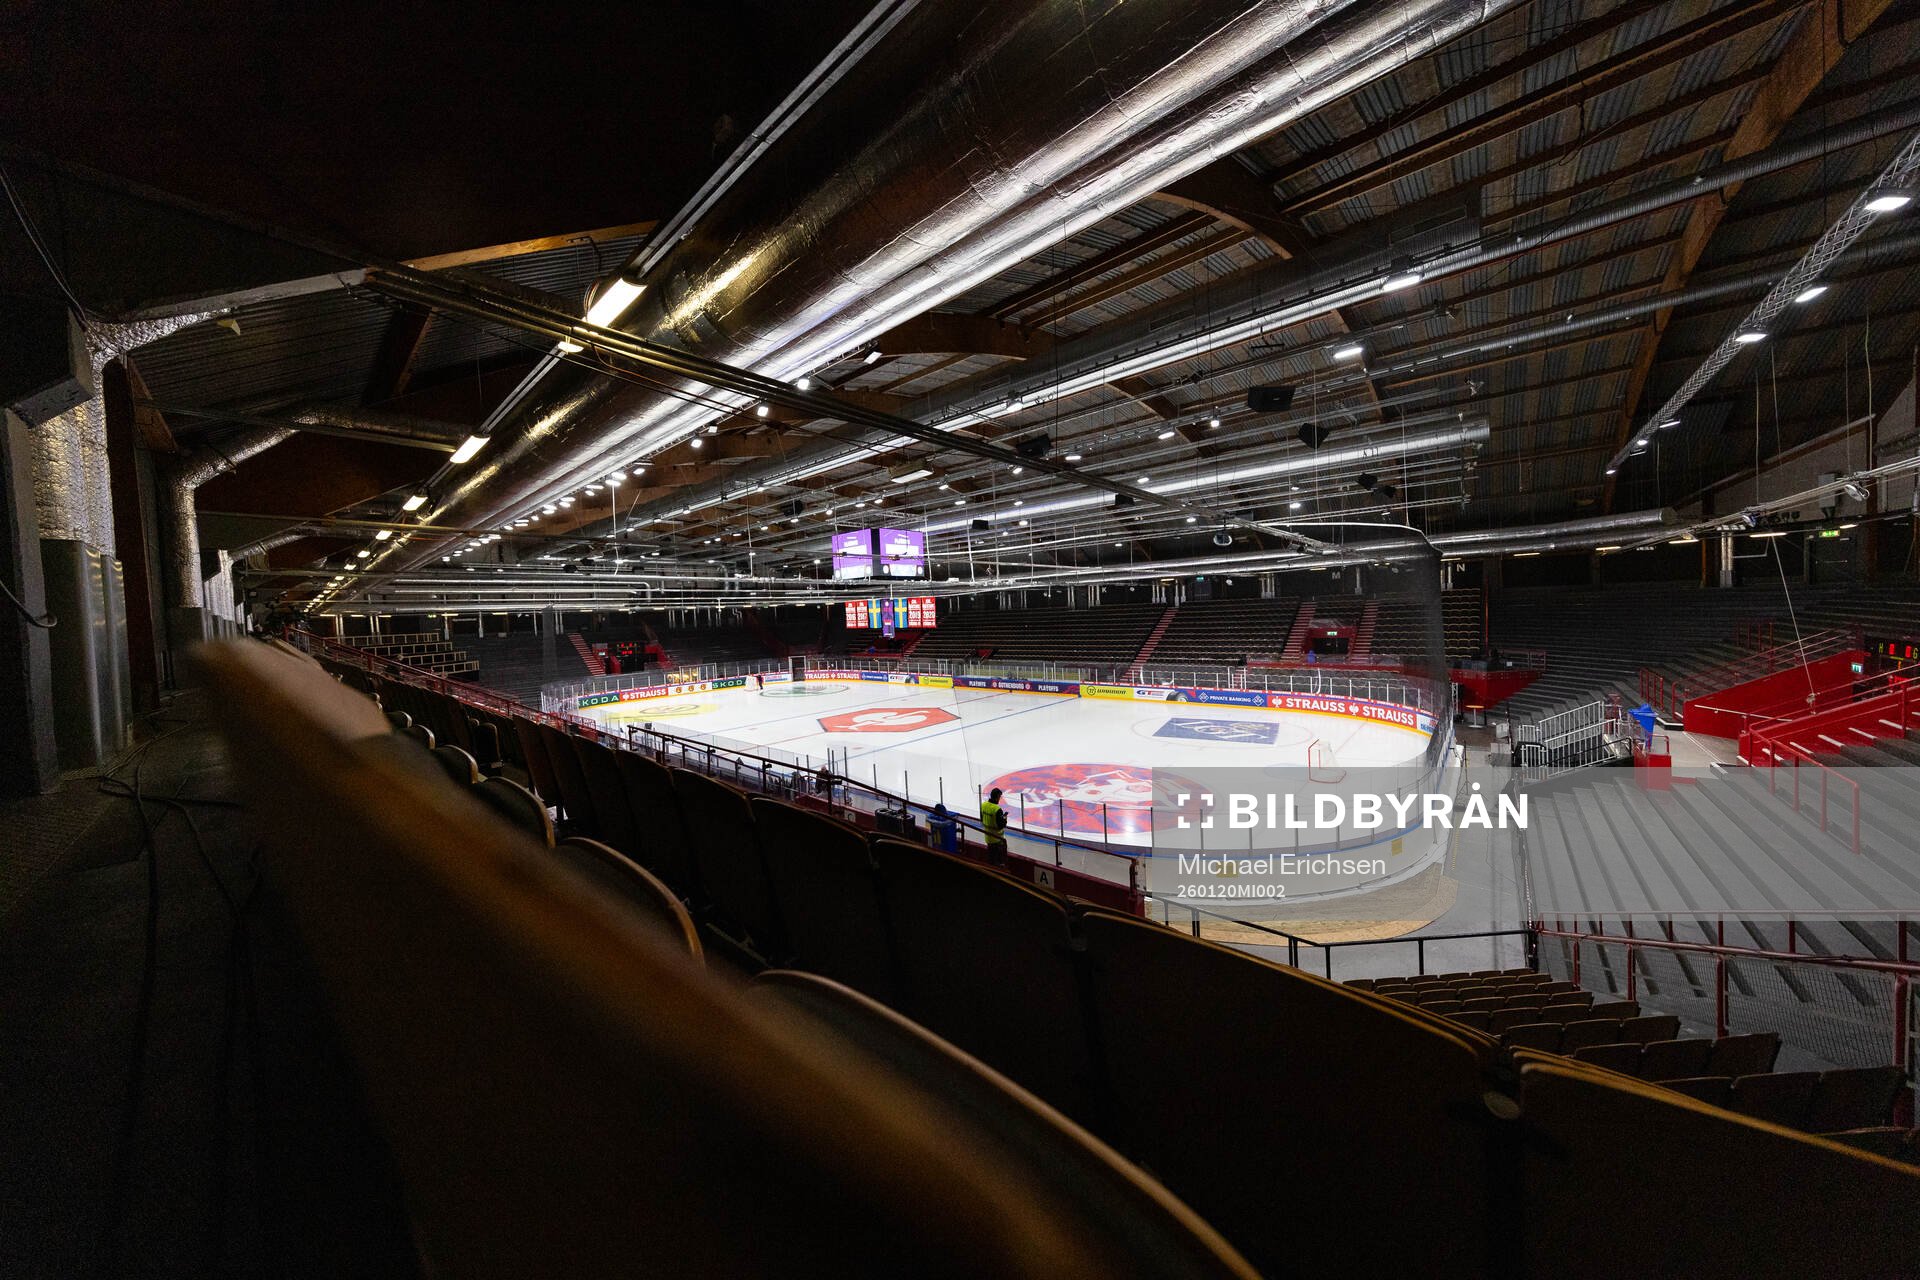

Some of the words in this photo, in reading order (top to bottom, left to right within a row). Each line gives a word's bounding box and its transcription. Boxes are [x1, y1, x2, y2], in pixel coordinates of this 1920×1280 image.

[1456, 563, 1465, 572] N
[712, 679, 743, 689] SKOD
[1038, 684, 1059, 692] PLAYOFFS
[629, 690, 667, 700] STRAUSS
[1286, 698, 1345, 713] STRAUSS
[1362, 705, 1414, 726] STRAUSS
[1040, 871, 1049, 885] A
